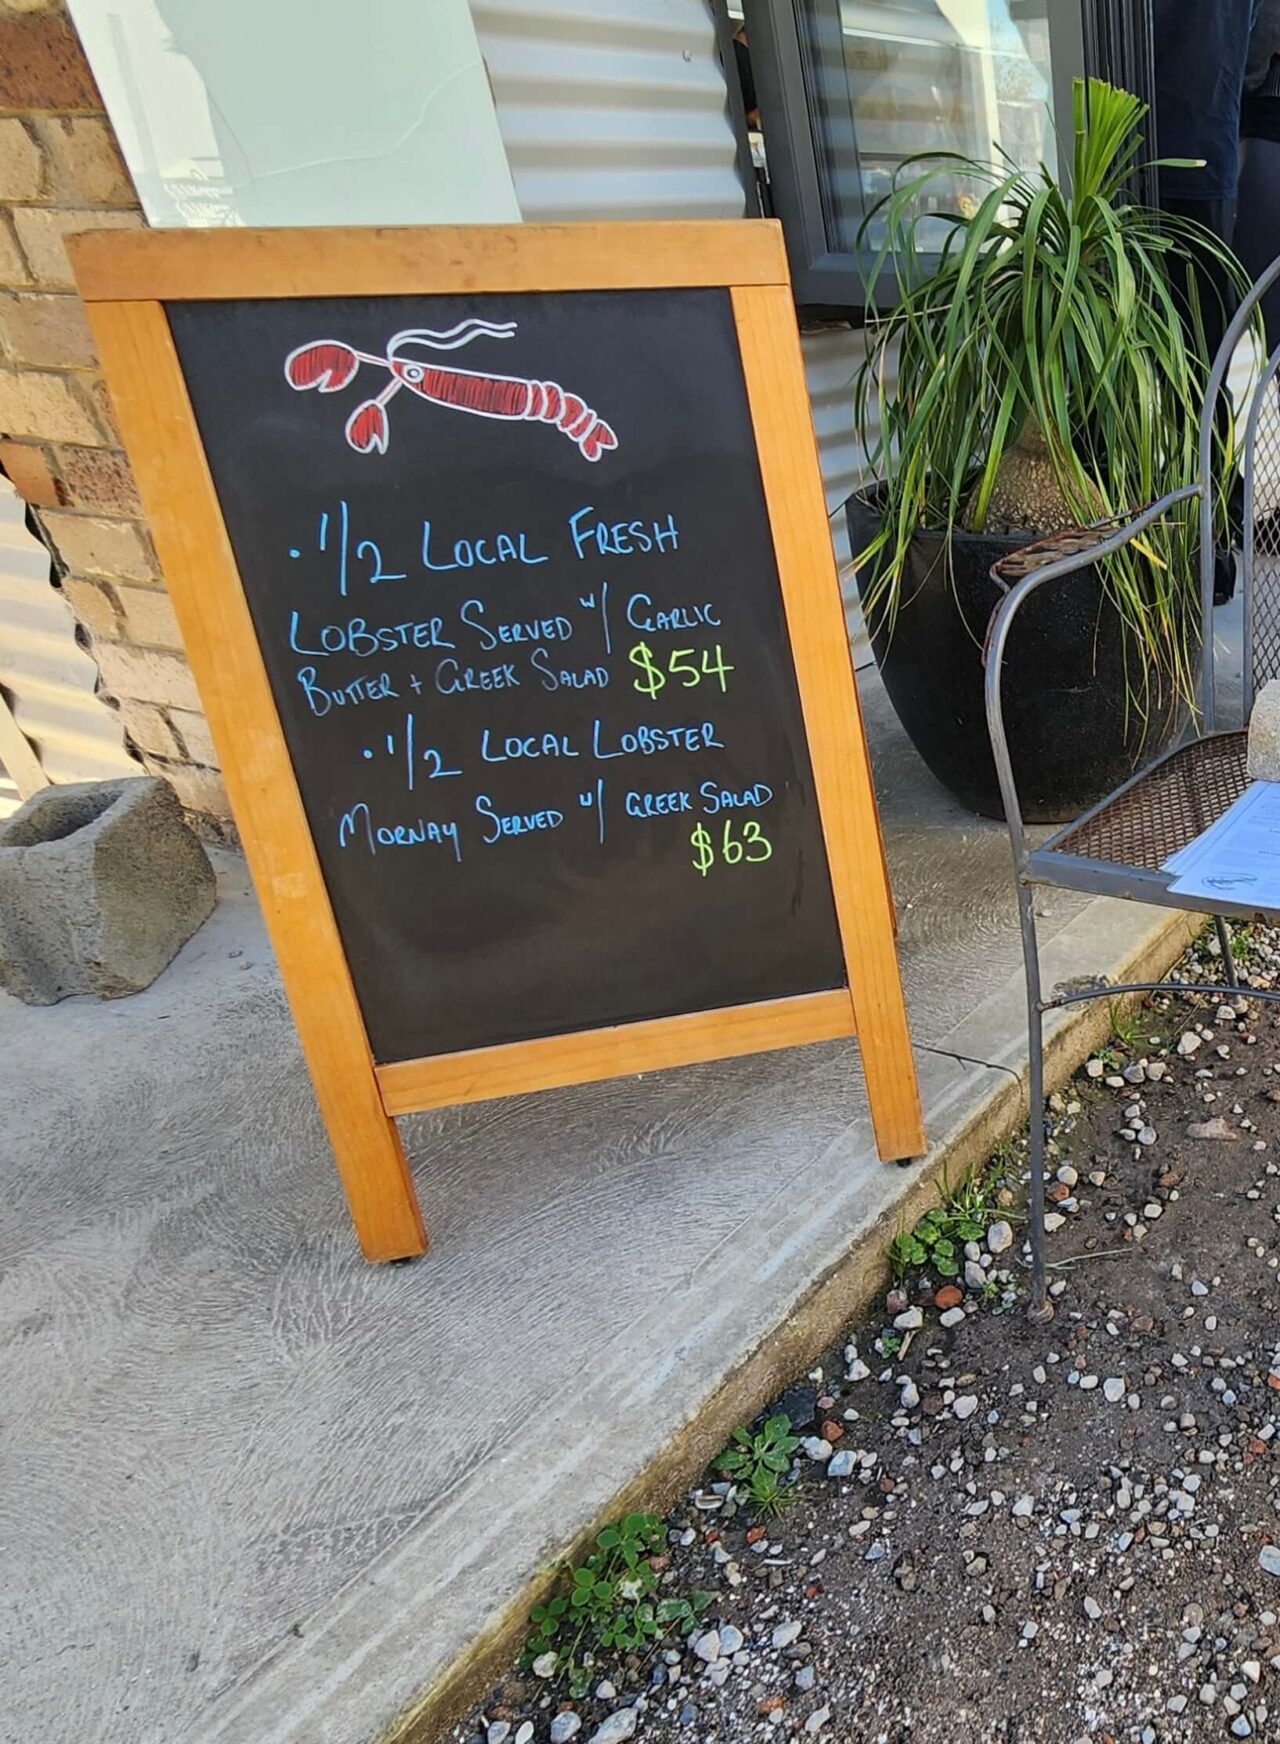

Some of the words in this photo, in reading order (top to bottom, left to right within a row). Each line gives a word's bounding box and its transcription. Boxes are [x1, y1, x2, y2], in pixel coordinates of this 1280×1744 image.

[320, 501, 406, 596] 1/2
[422, 521, 548, 570] LOCAL
[569, 507, 678, 558] FRESH
[290, 611, 455, 656] LOBSTER
[461, 600, 572, 650] SERVED
[627, 594, 721, 631] GARLIC
[297, 666, 399, 716] BUTTER
[437, 659, 520, 694] GREEK
[531, 648, 608, 690] SALAD
[629, 642, 734, 700] $54
[387, 714, 462, 790] 1/2
[482, 730, 579, 761] LOCAL
[593, 720, 724, 758] LOBSTER
[340, 803, 461, 861] MORNAY
[476, 796, 563, 843] SERVED
[626, 792, 692, 817] GREEK
[700, 782, 772, 813] SALAD
[691, 820, 772, 876] $63
